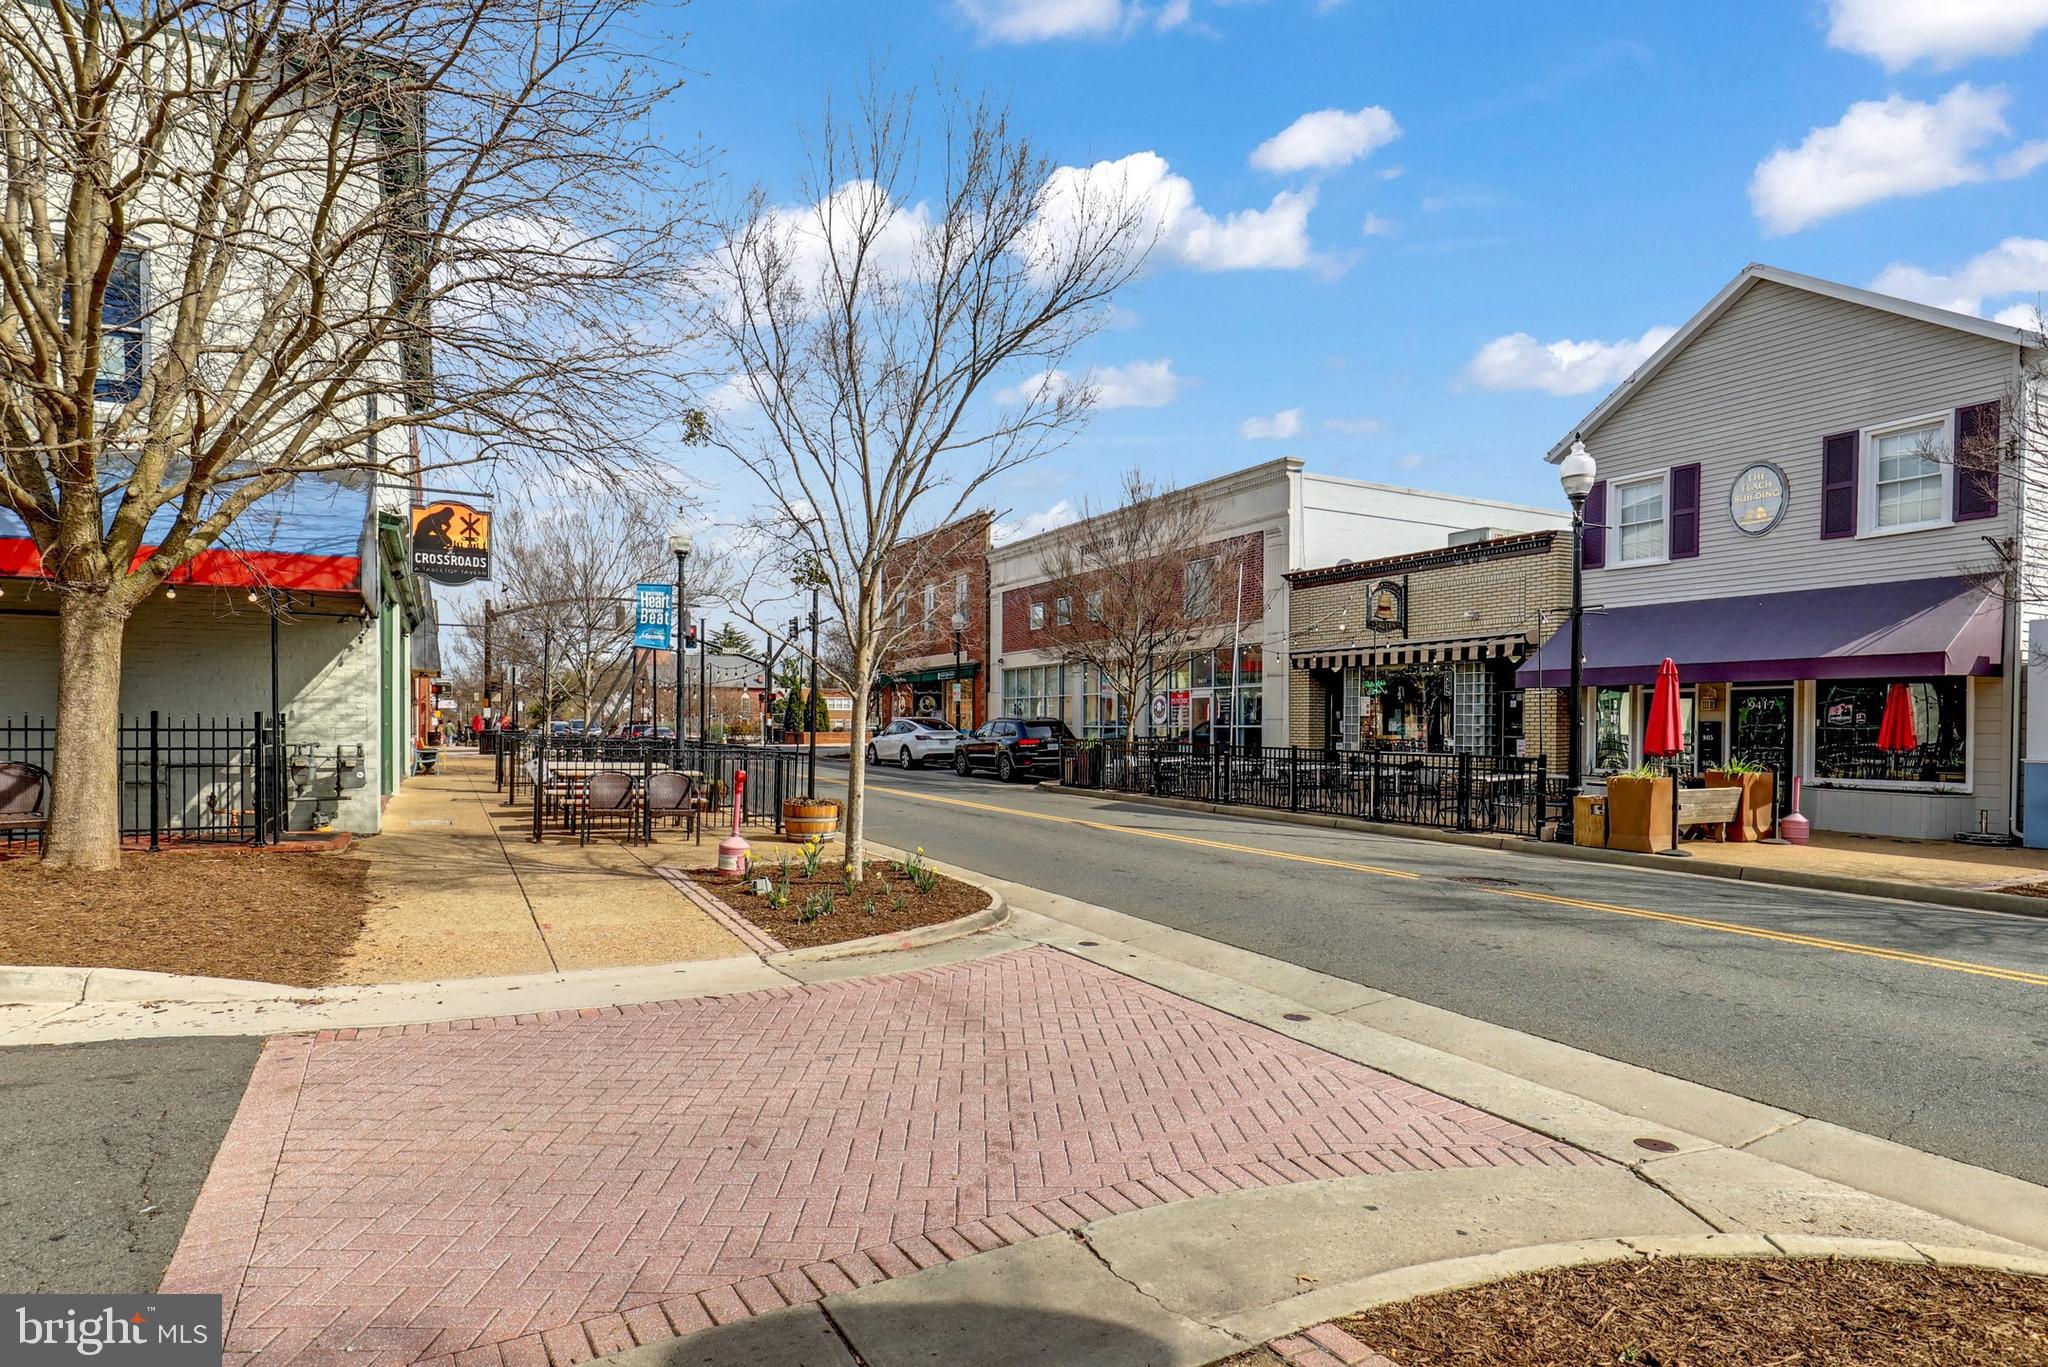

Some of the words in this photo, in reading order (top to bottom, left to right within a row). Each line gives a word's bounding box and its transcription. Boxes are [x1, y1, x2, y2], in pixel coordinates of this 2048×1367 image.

[1748, 472, 1766, 481] THE
[1734, 489, 1780, 504] BUILDING
[414, 552, 487, 568] CROSSROADS
[640, 591, 670, 609] Heart
[640, 608, 670, 625] Beat
[1748, 700, 1775, 710] 9417
